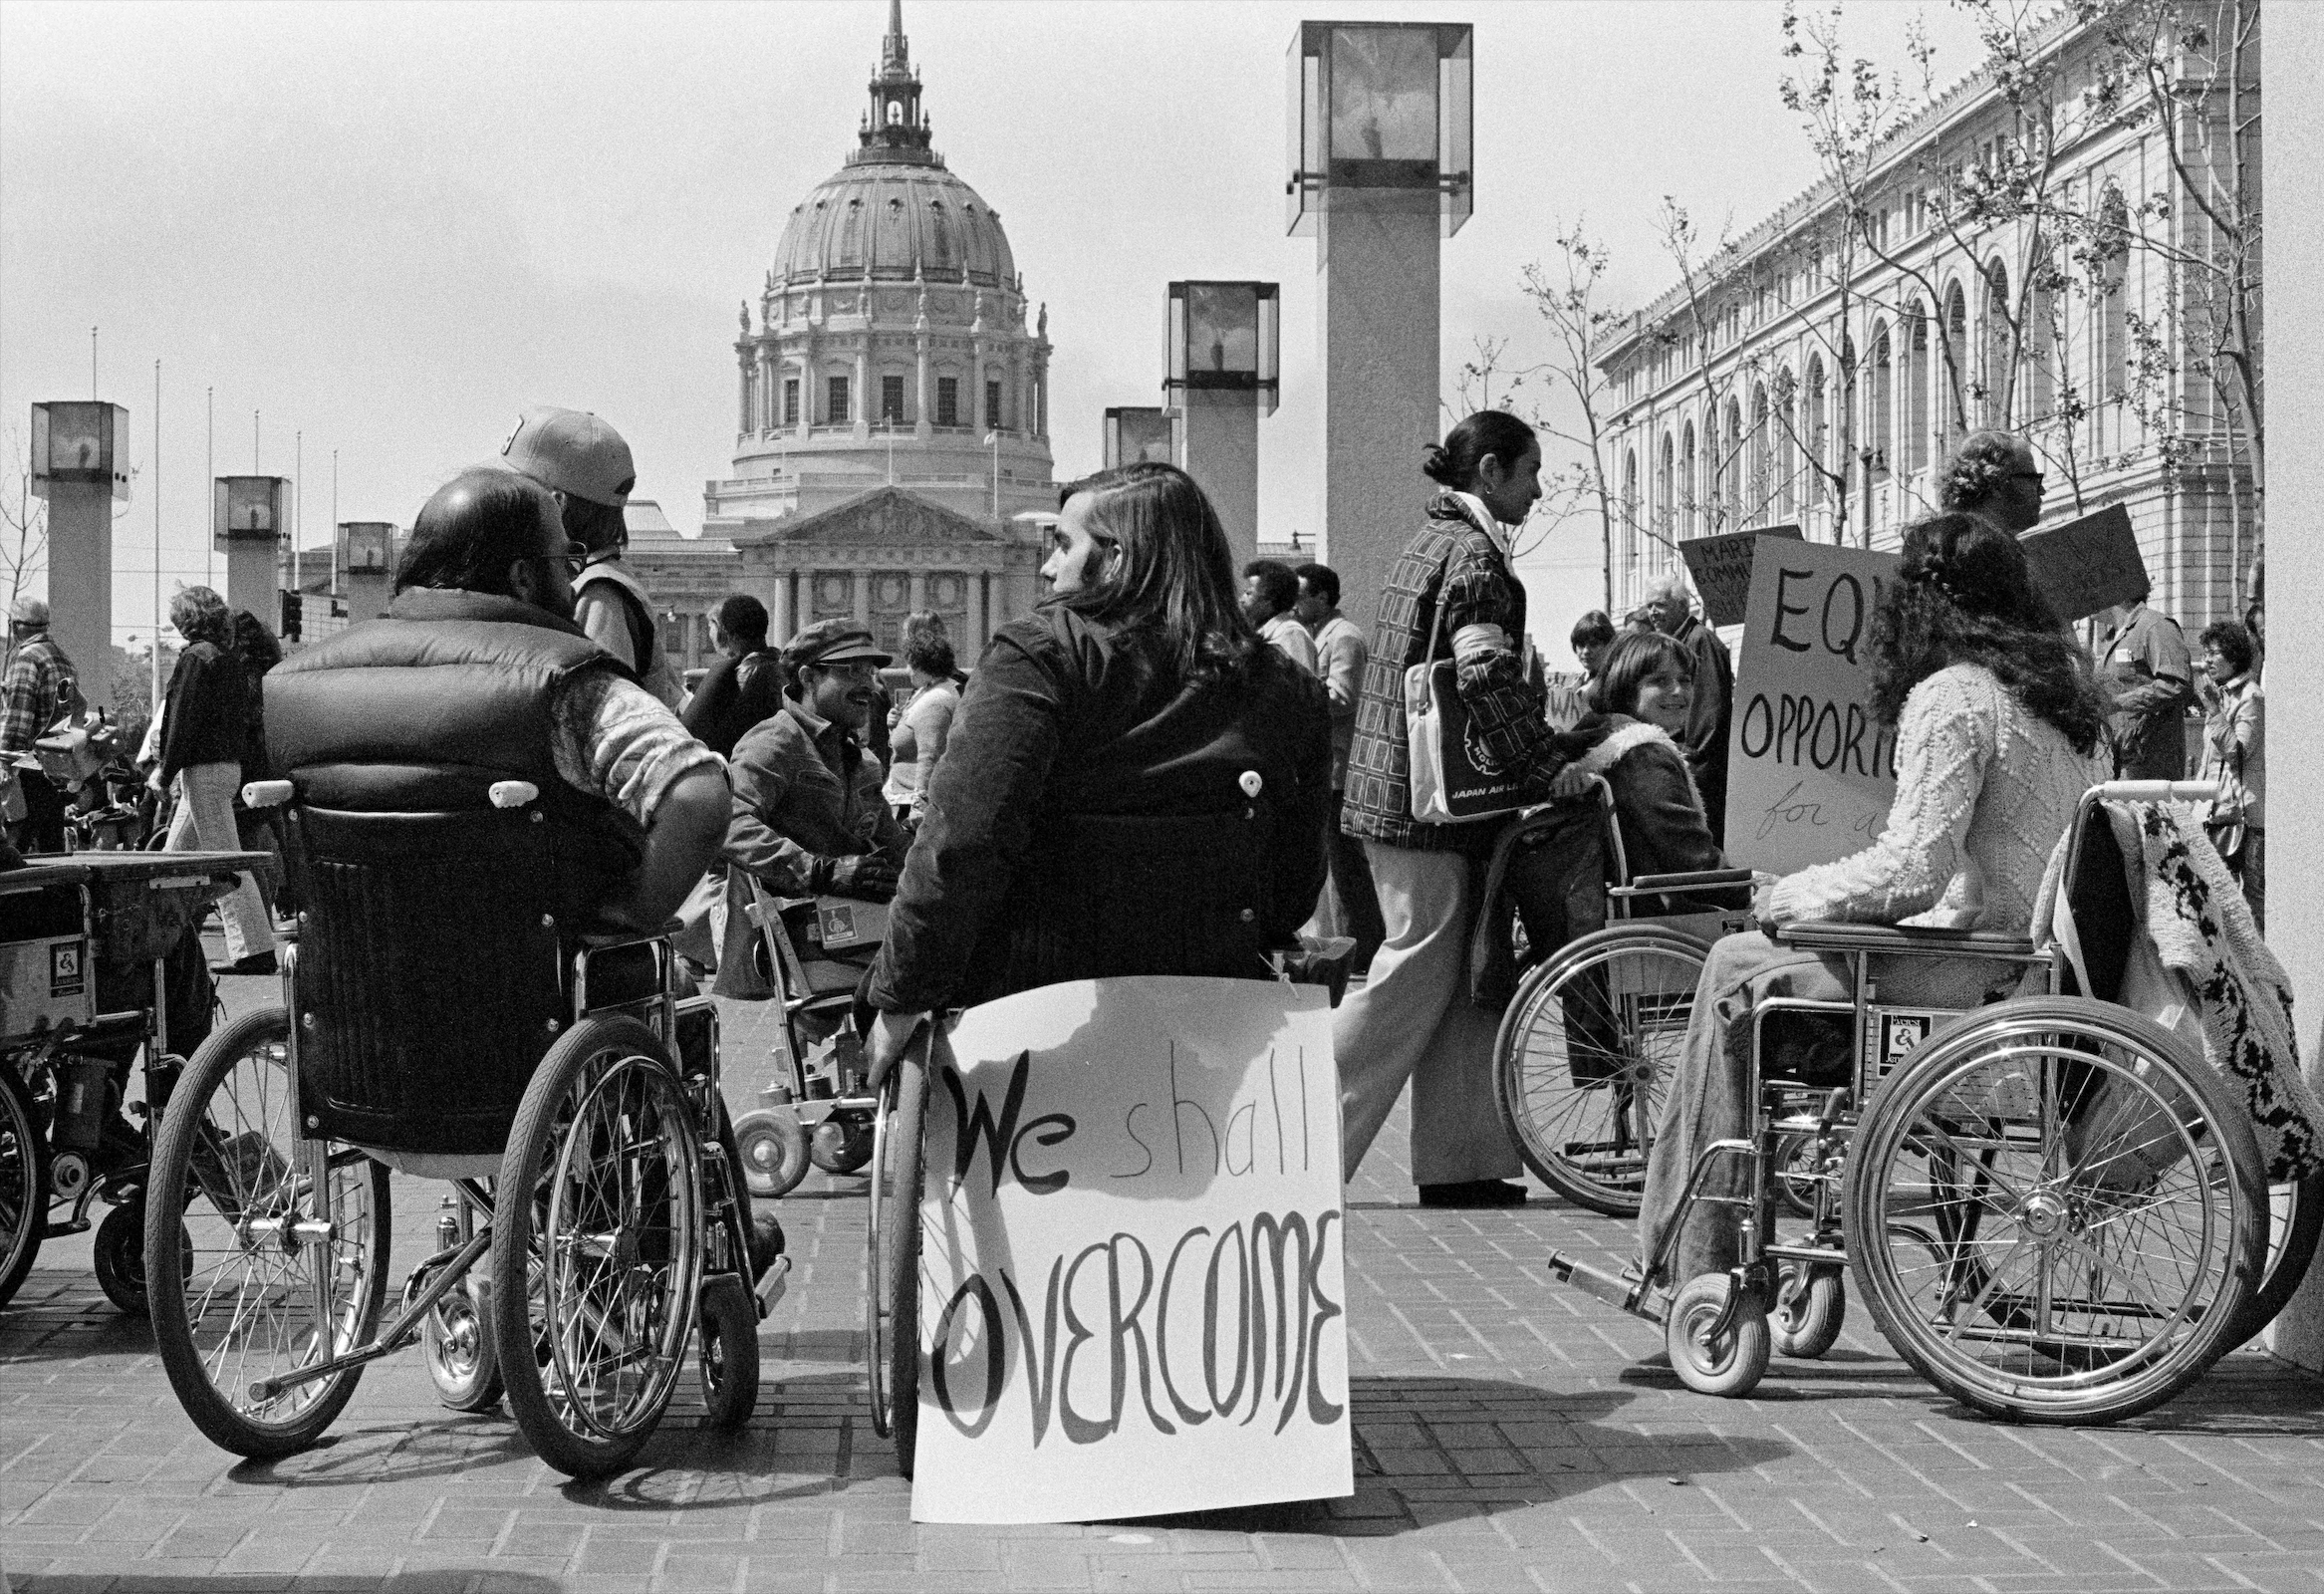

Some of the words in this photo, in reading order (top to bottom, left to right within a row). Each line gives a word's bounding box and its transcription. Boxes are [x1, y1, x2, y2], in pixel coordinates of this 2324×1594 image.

[1770, 568, 1883, 665] EQ
[1451, 787, 1486, 800] JAPAN
[1488, 784, 1505, 795] AIR
[1756, 781, 1830, 841] for
[940, 1049, 1077, 1204] We
[1109, 1040, 1309, 1178] shall
[931, 1208, 1345, 1452] OVERCOME
